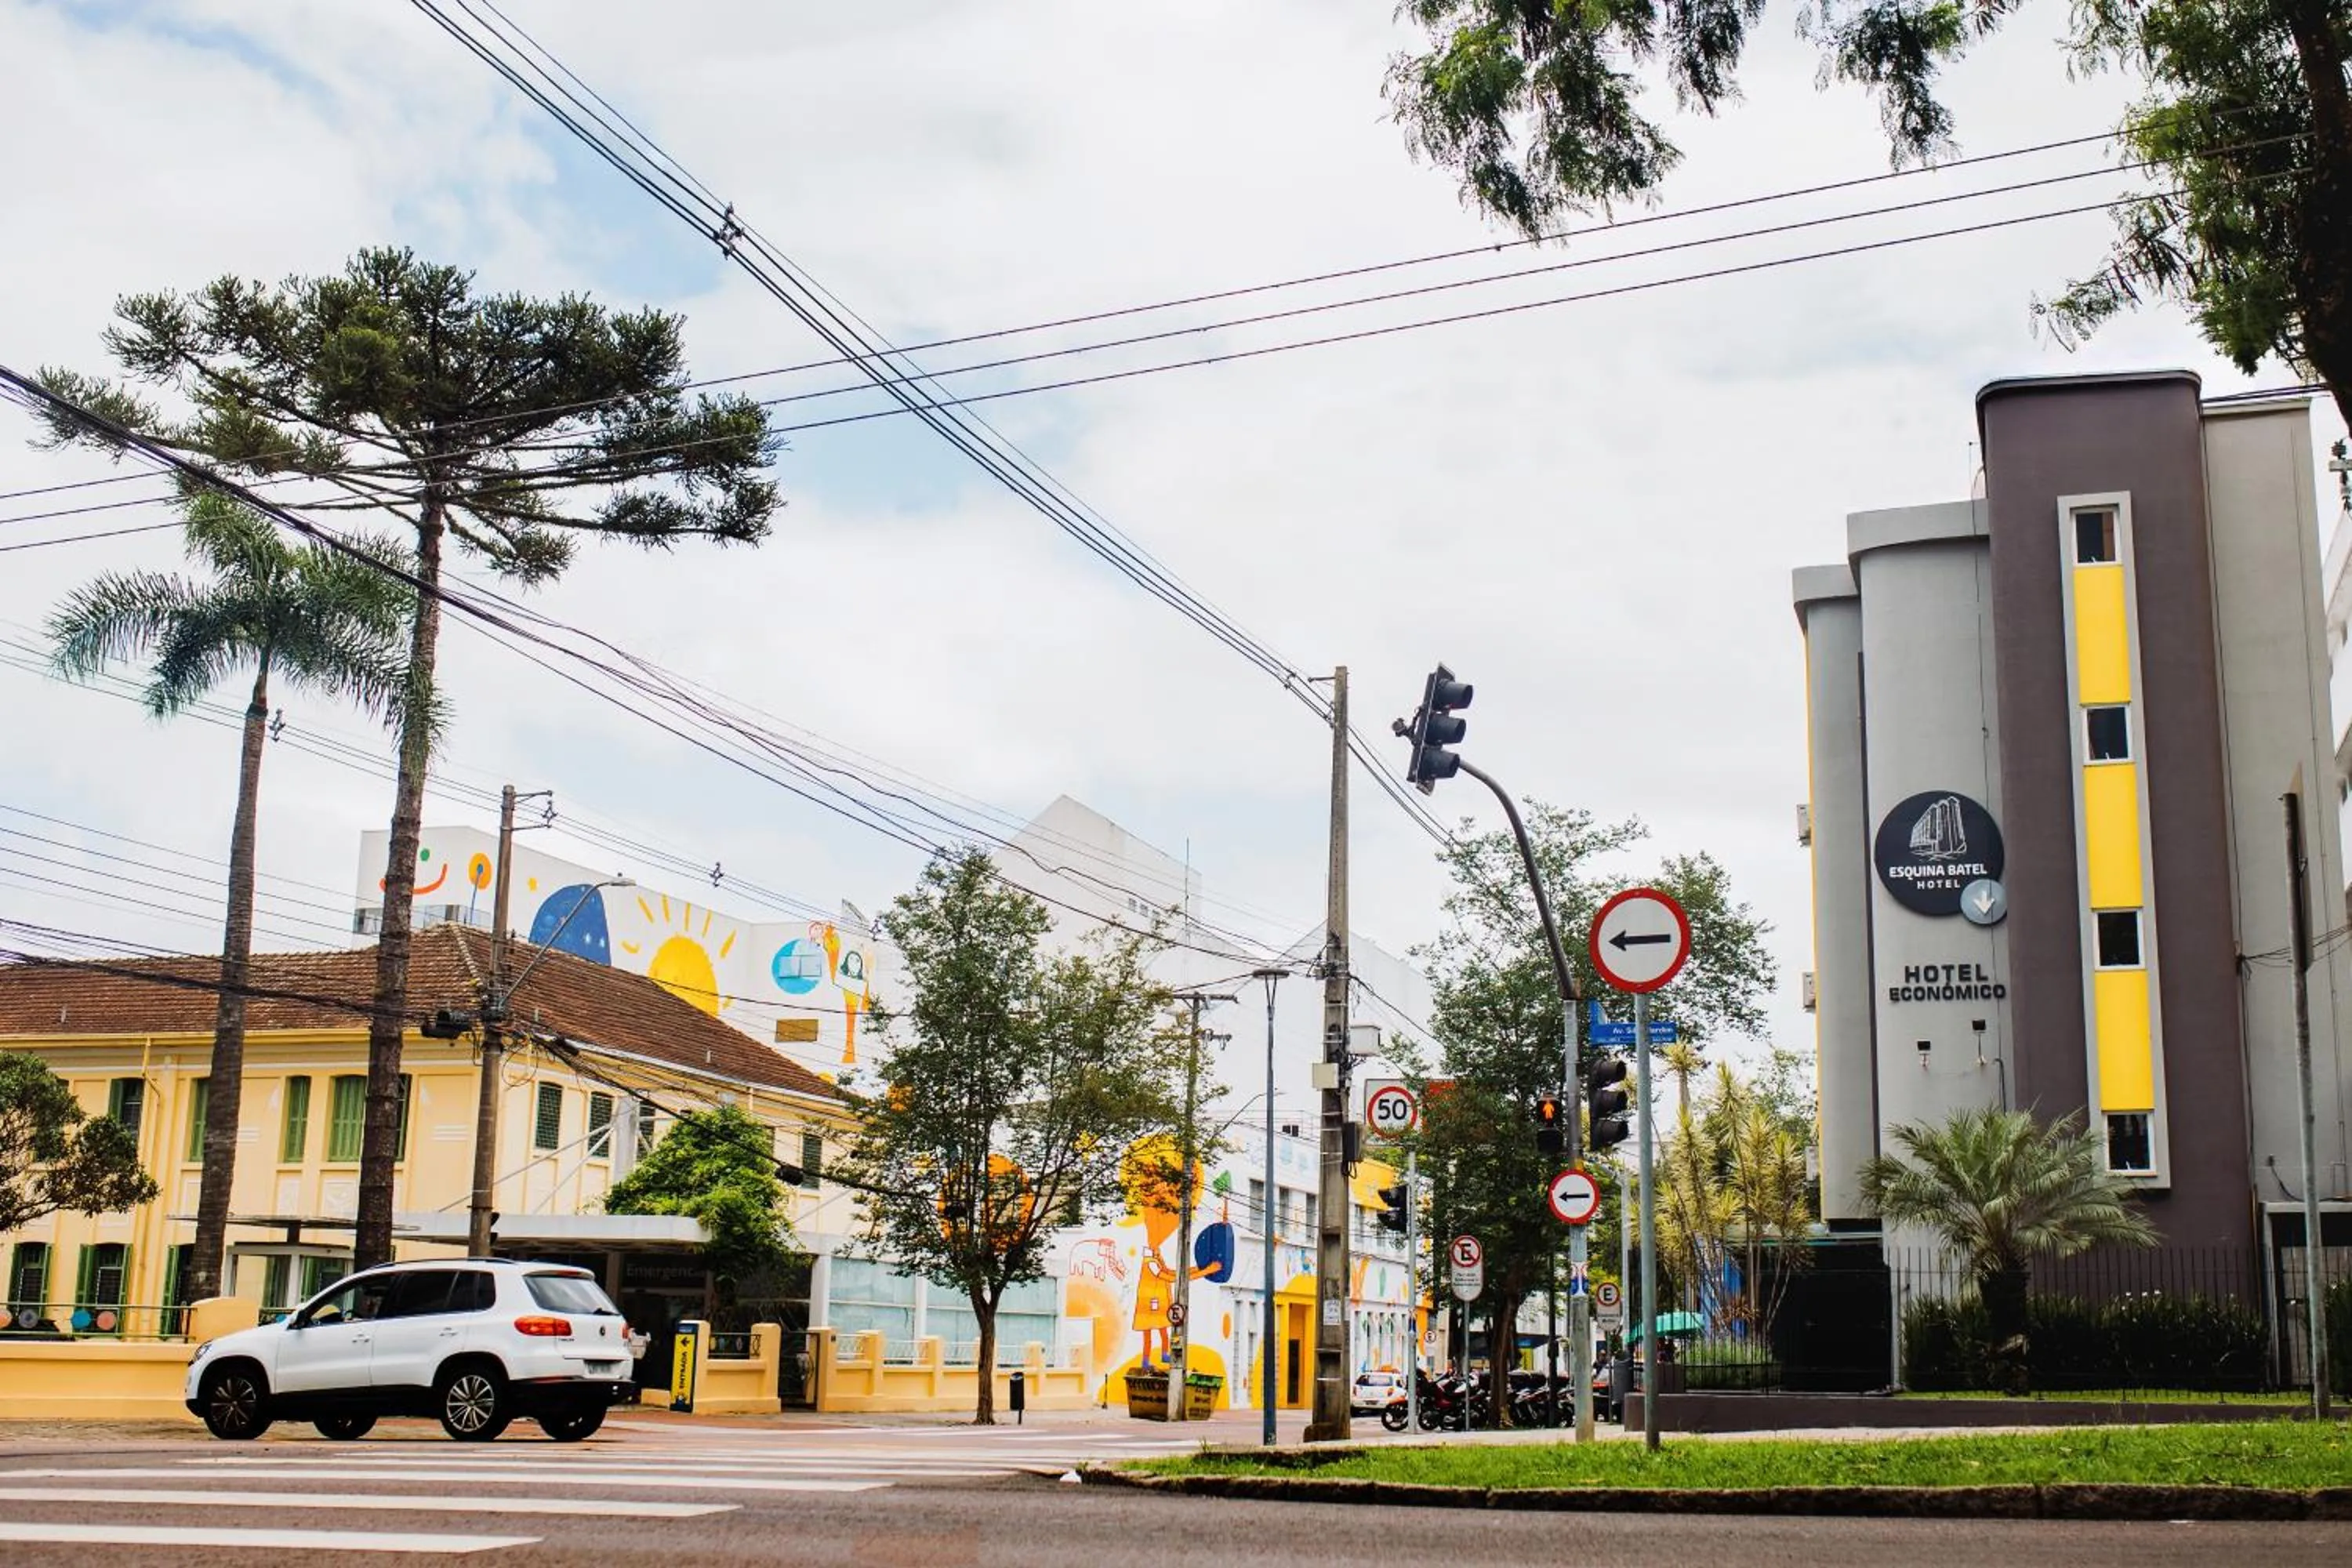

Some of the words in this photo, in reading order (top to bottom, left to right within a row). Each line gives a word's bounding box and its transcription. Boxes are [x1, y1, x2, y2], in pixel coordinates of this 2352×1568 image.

[1889, 865, 1945, 880] ESQUINA
[1947, 863, 1987, 876] BATEL
[1917, 880, 1961, 890] HOTEL
[1904, 964, 1989, 984] HOTEL
[1377, 1098, 1407, 1120] 50
[1461, 1243, 1472, 1261] E
[1603, 1287, 1613, 1301] E
